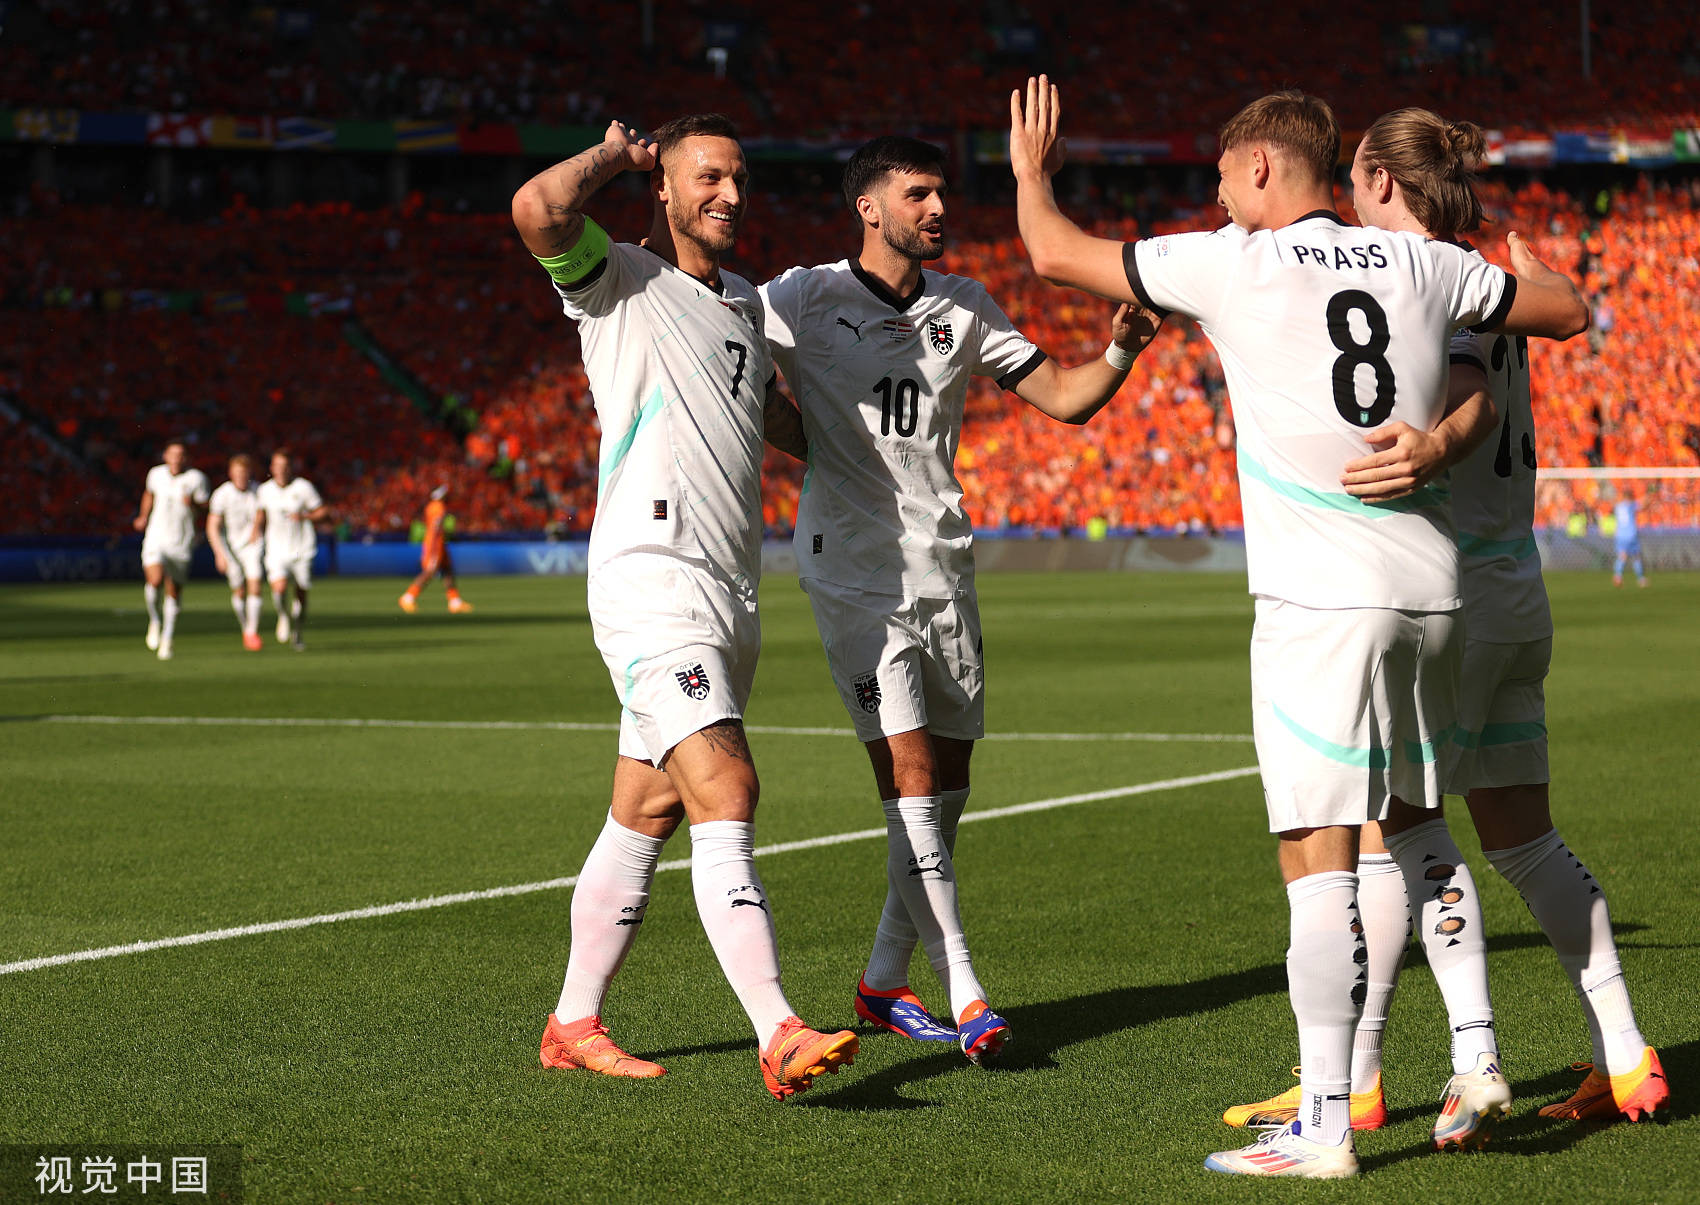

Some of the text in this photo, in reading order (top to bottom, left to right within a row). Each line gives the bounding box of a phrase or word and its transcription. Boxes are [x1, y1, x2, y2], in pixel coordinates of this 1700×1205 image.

[1292, 244, 1388, 270] PRASS
[725, 340, 747, 400] 7
[1326, 289, 1396, 428] 8
[872, 376, 919, 438] 10
[1311, 1094, 1322, 1129] DESIGN
